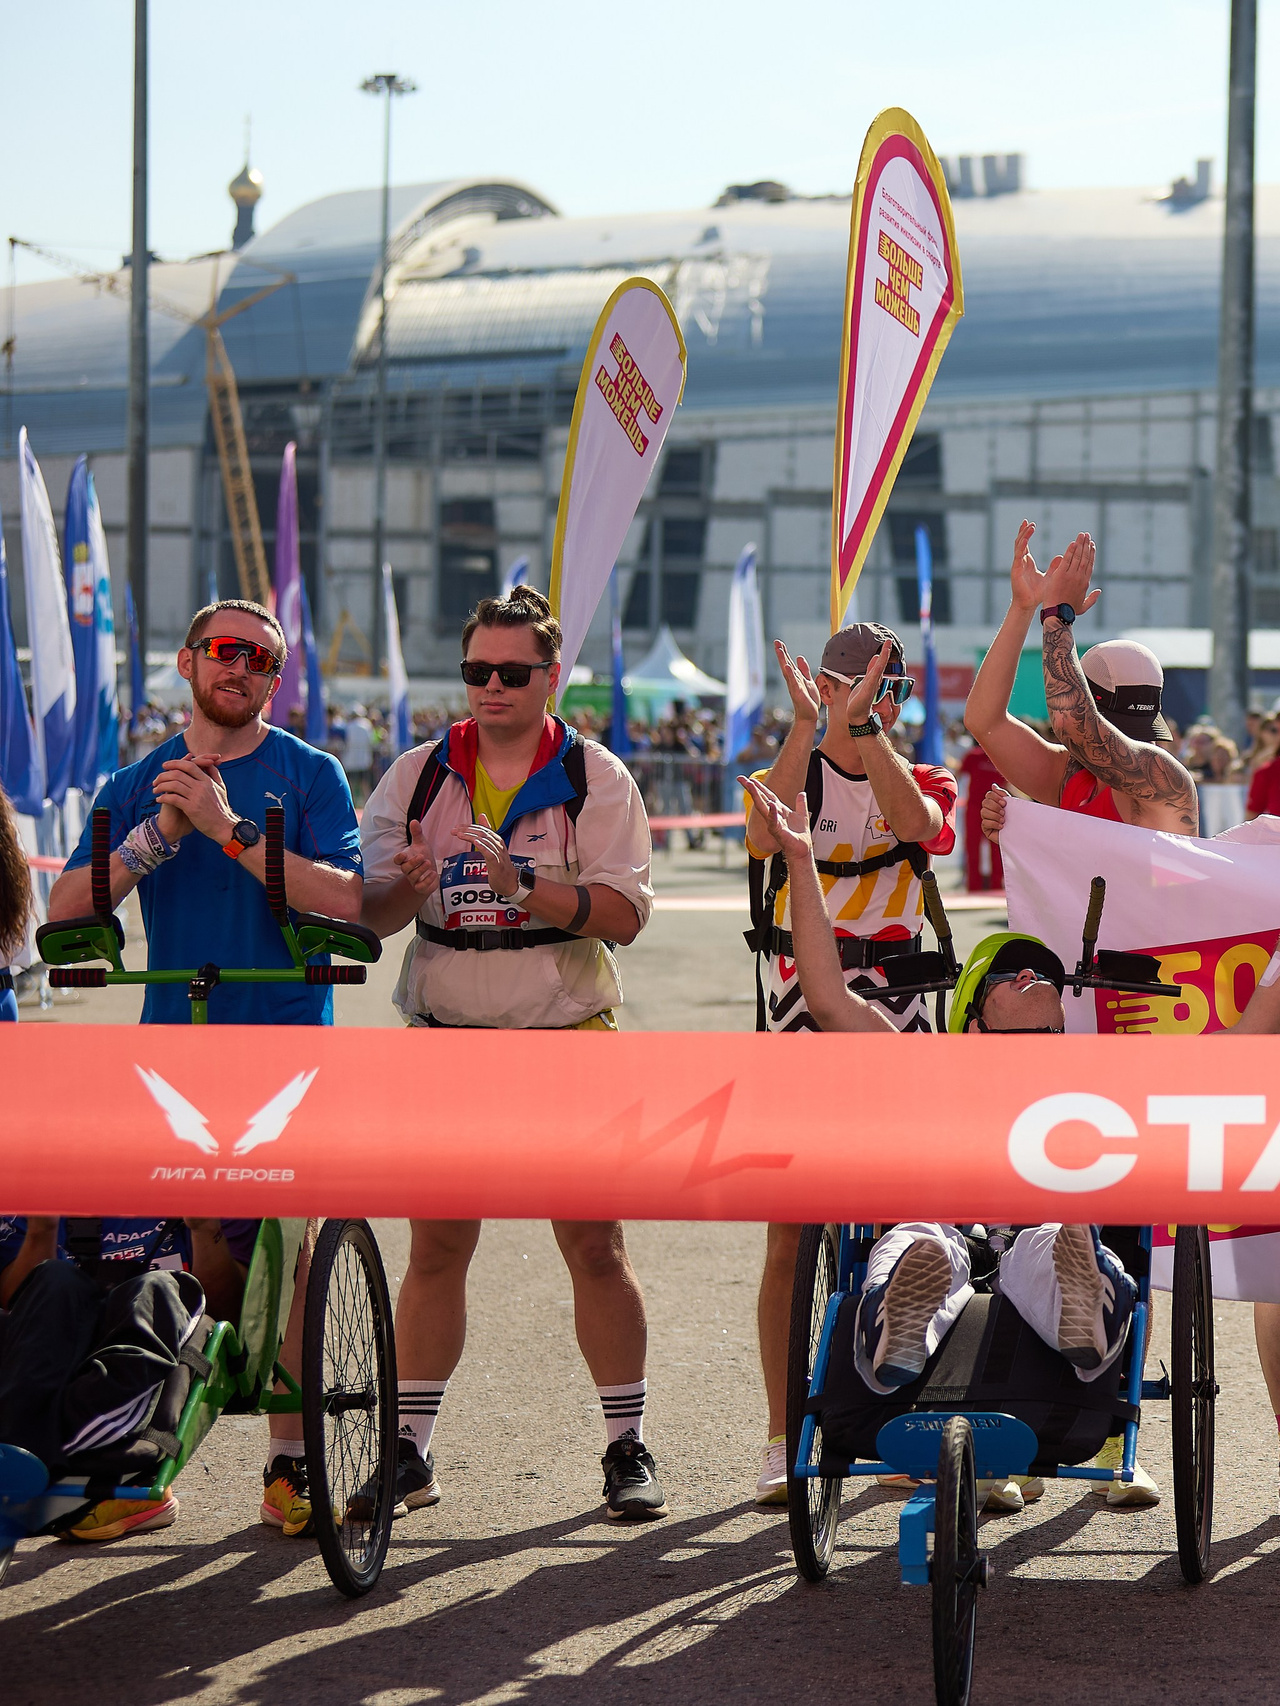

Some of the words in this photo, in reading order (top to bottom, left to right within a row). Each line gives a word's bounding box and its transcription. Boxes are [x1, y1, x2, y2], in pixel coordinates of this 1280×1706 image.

[879, 233, 923, 291] БОЛЬШЕ
[889, 265, 910, 300] ЧЕМ
[876, 280, 920, 336] МОЖЕШЬ
[610, 337, 662, 424] БОЛЬШЕ
[617, 371, 641, 417] ЧЕМ
[597, 368, 645, 453] МОЖЕШЬ
[462, 915, 473, 923] 10
[476, 915, 495, 923] KM
[151, 1167, 207, 1180] ЛИГА
[214, 1168, 295, 1182] ГЕРОЕВ
